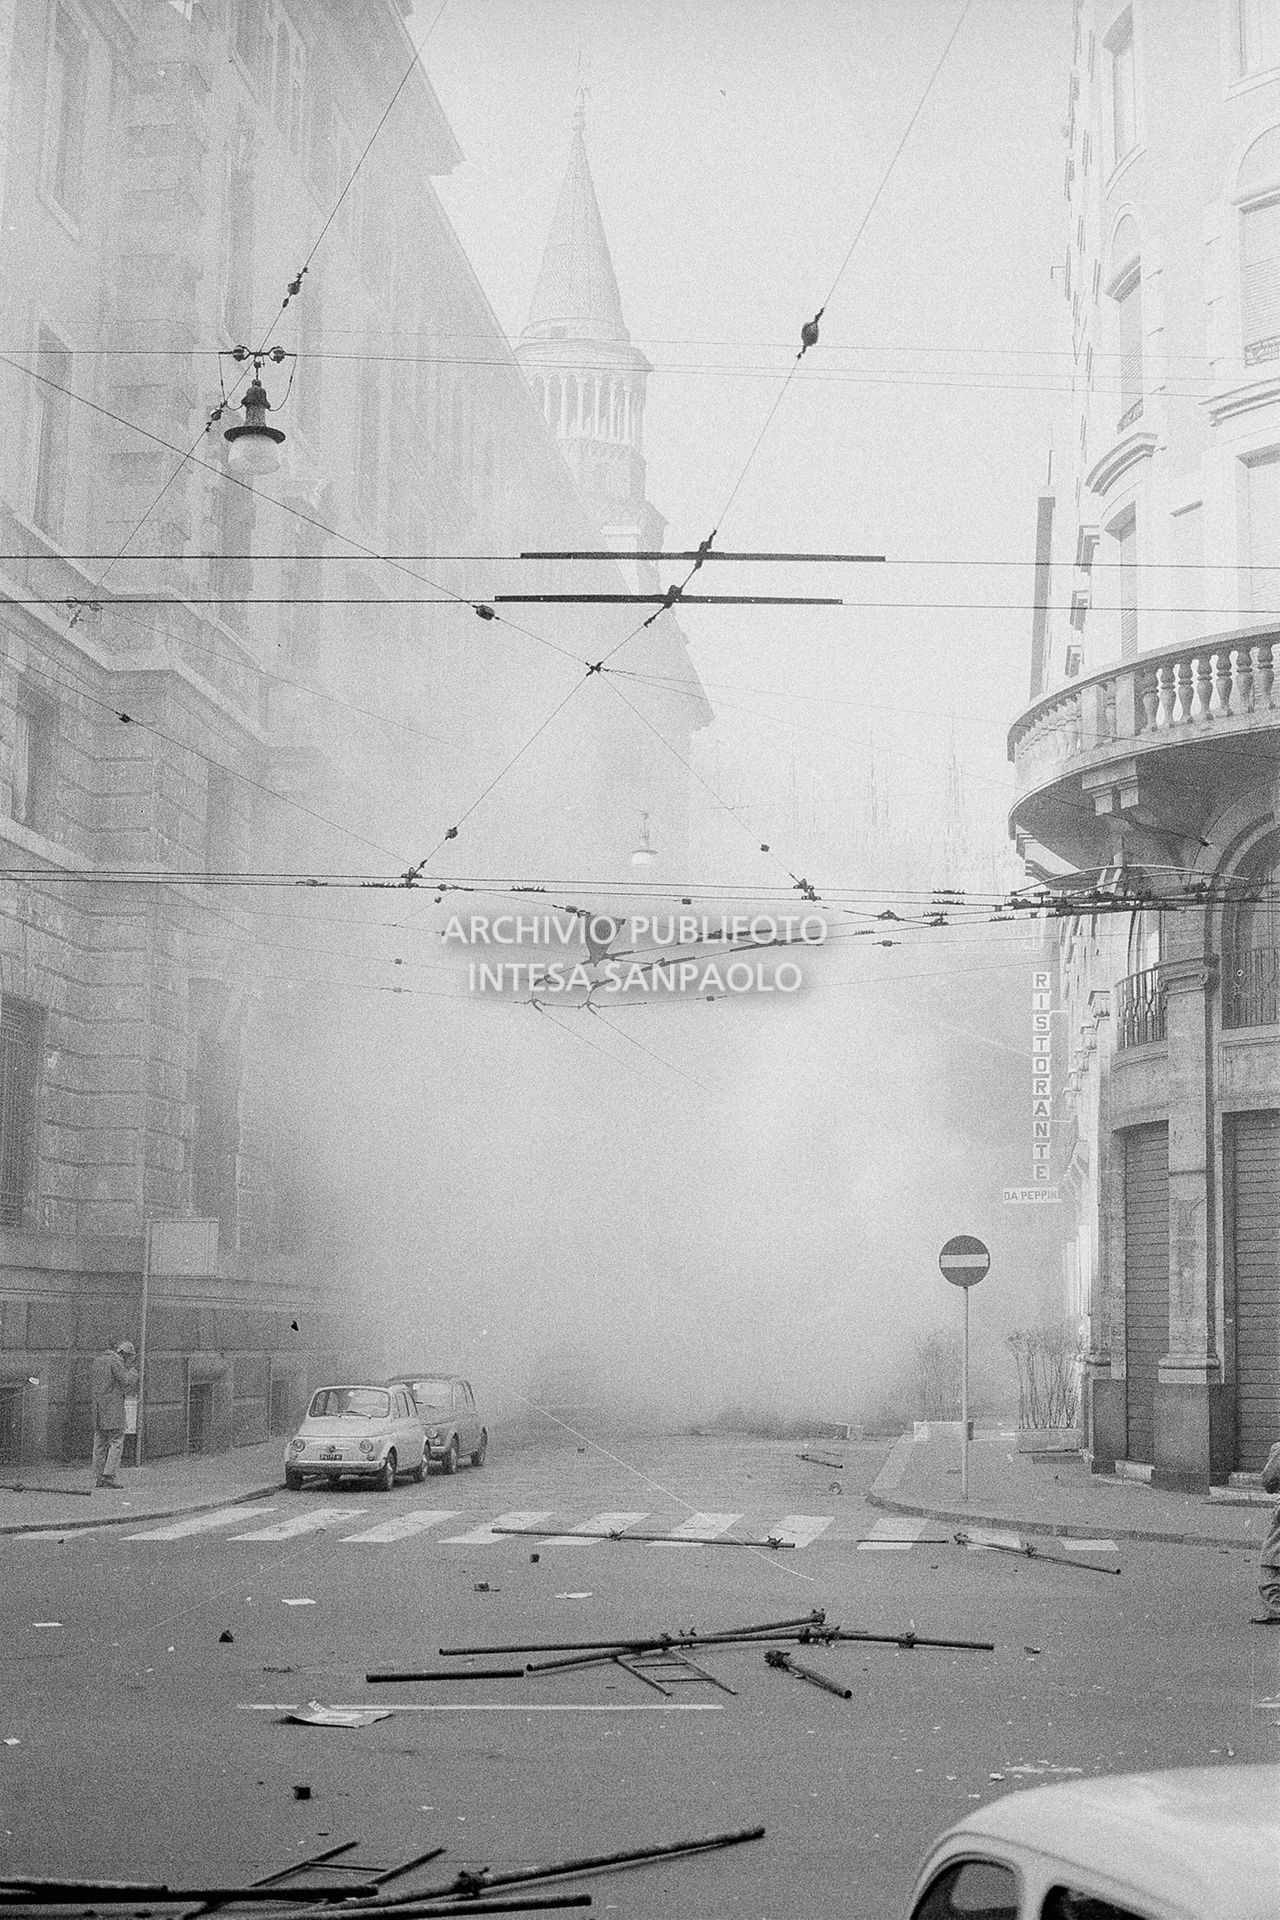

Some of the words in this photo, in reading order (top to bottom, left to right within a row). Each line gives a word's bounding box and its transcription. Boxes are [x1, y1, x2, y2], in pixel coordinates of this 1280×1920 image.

[1035, 974, 1048, 1179] RISTORANTE
[1003, 1190, 1018, 1200] DA
[1020, 1190, 1062, 1200] PEPPIN
